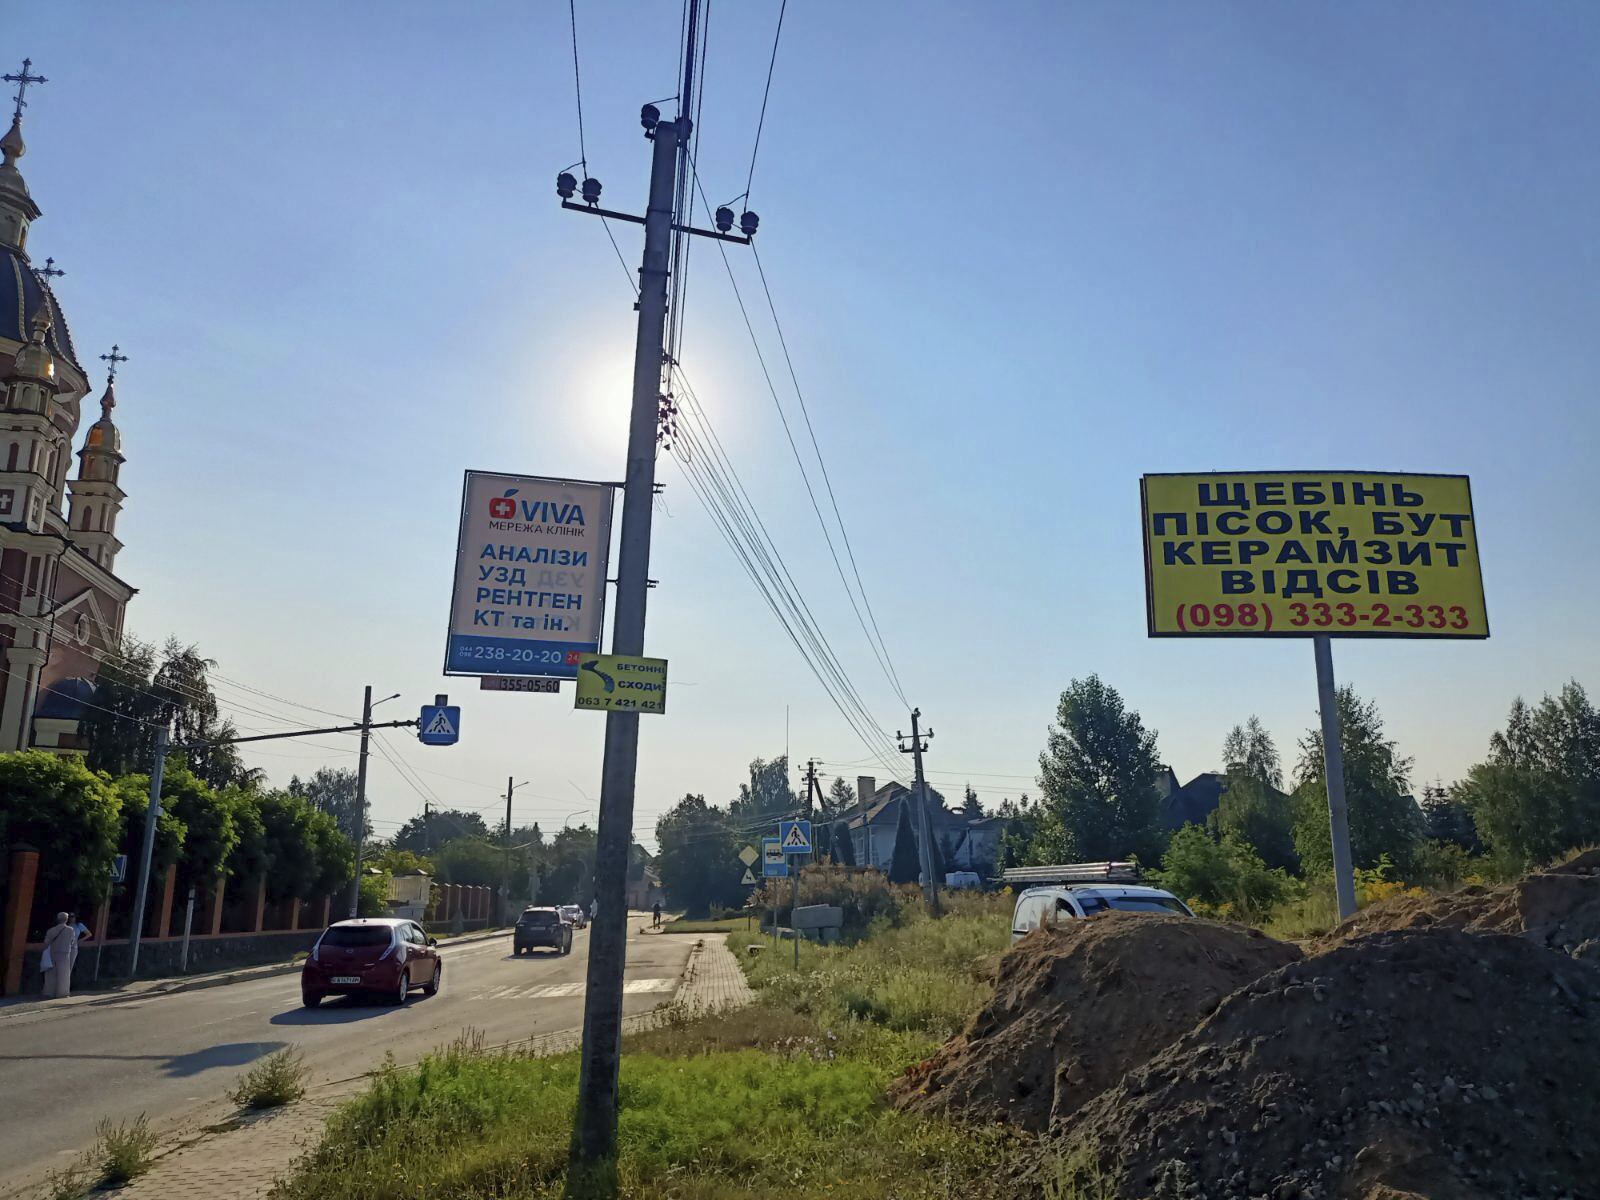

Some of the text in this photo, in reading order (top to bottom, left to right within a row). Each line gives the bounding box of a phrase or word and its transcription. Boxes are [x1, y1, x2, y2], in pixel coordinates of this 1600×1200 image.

[1198, 481, 1424, 511] ЩЕБІНЬ
[521, 500, 585, 526] VIVA
[1153, 510, 1471, 540] ПІСОК, БУТ
[488, 521, 585, 537] МЕРЕЖА КЛІНІК
[480, 543, 588, 567] АНАЛІЗИ
[1163, 539, 1467, 567] КЕРАМЗИТ
[478, 564, 526, 587] УЗД
[1221, 569, 1420, 599] ВІДСІВ
[476, 587, 583, 611] РЕНТГЕН
[473, 609, 569, 631] КТ та ін.
[1176, 602, 1469, 632] (098) 333-2-333
[474, 646, 562, 664] 238-20-20
[577, 696, 600, 706] 063
[604, 698, 612, 706] 7
[615, 698, 637, 707] 421
